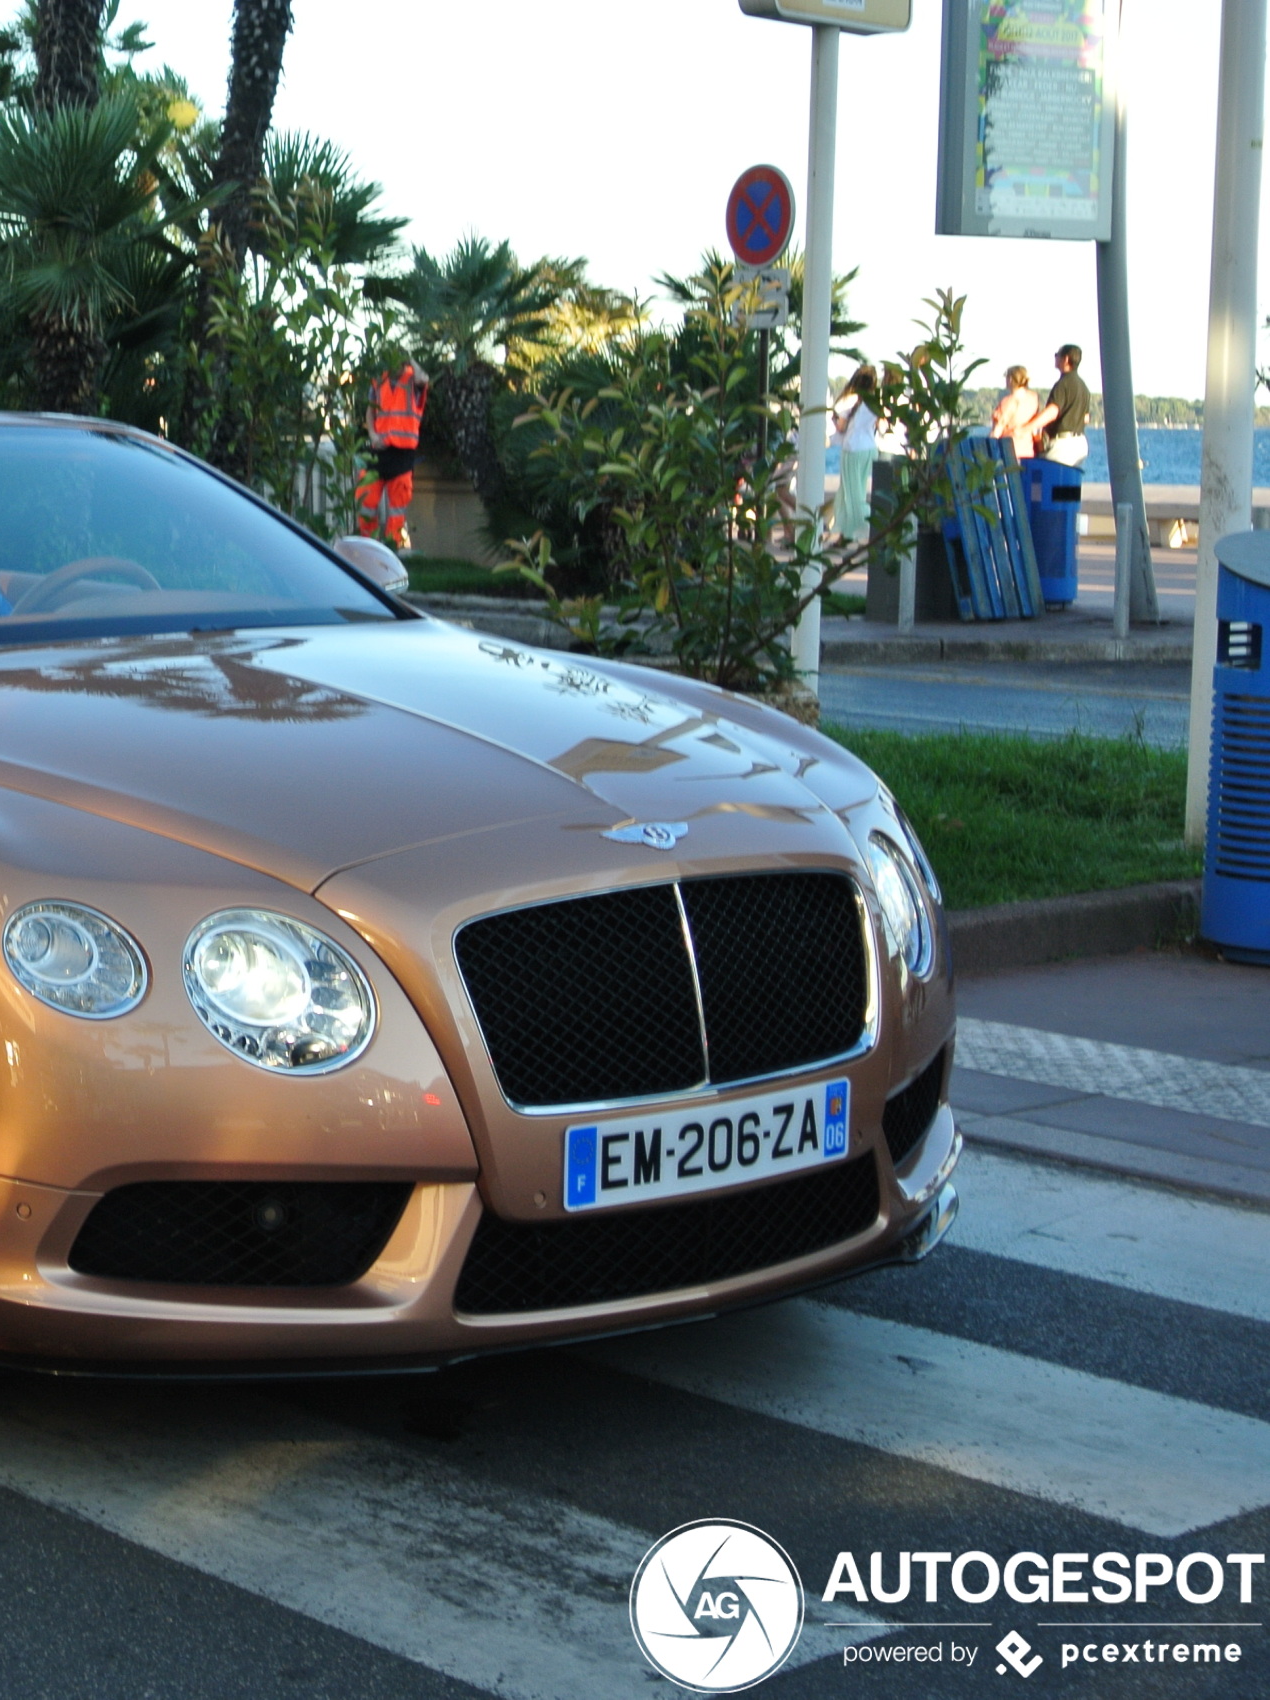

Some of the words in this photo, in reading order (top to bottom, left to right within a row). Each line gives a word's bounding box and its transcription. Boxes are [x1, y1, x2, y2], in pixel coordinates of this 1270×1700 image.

[577, 1174, 586, 1192] F
[600, 1099, 819, 1191] EM-206-ZA
[826, 1121, 844, 1150] 06
